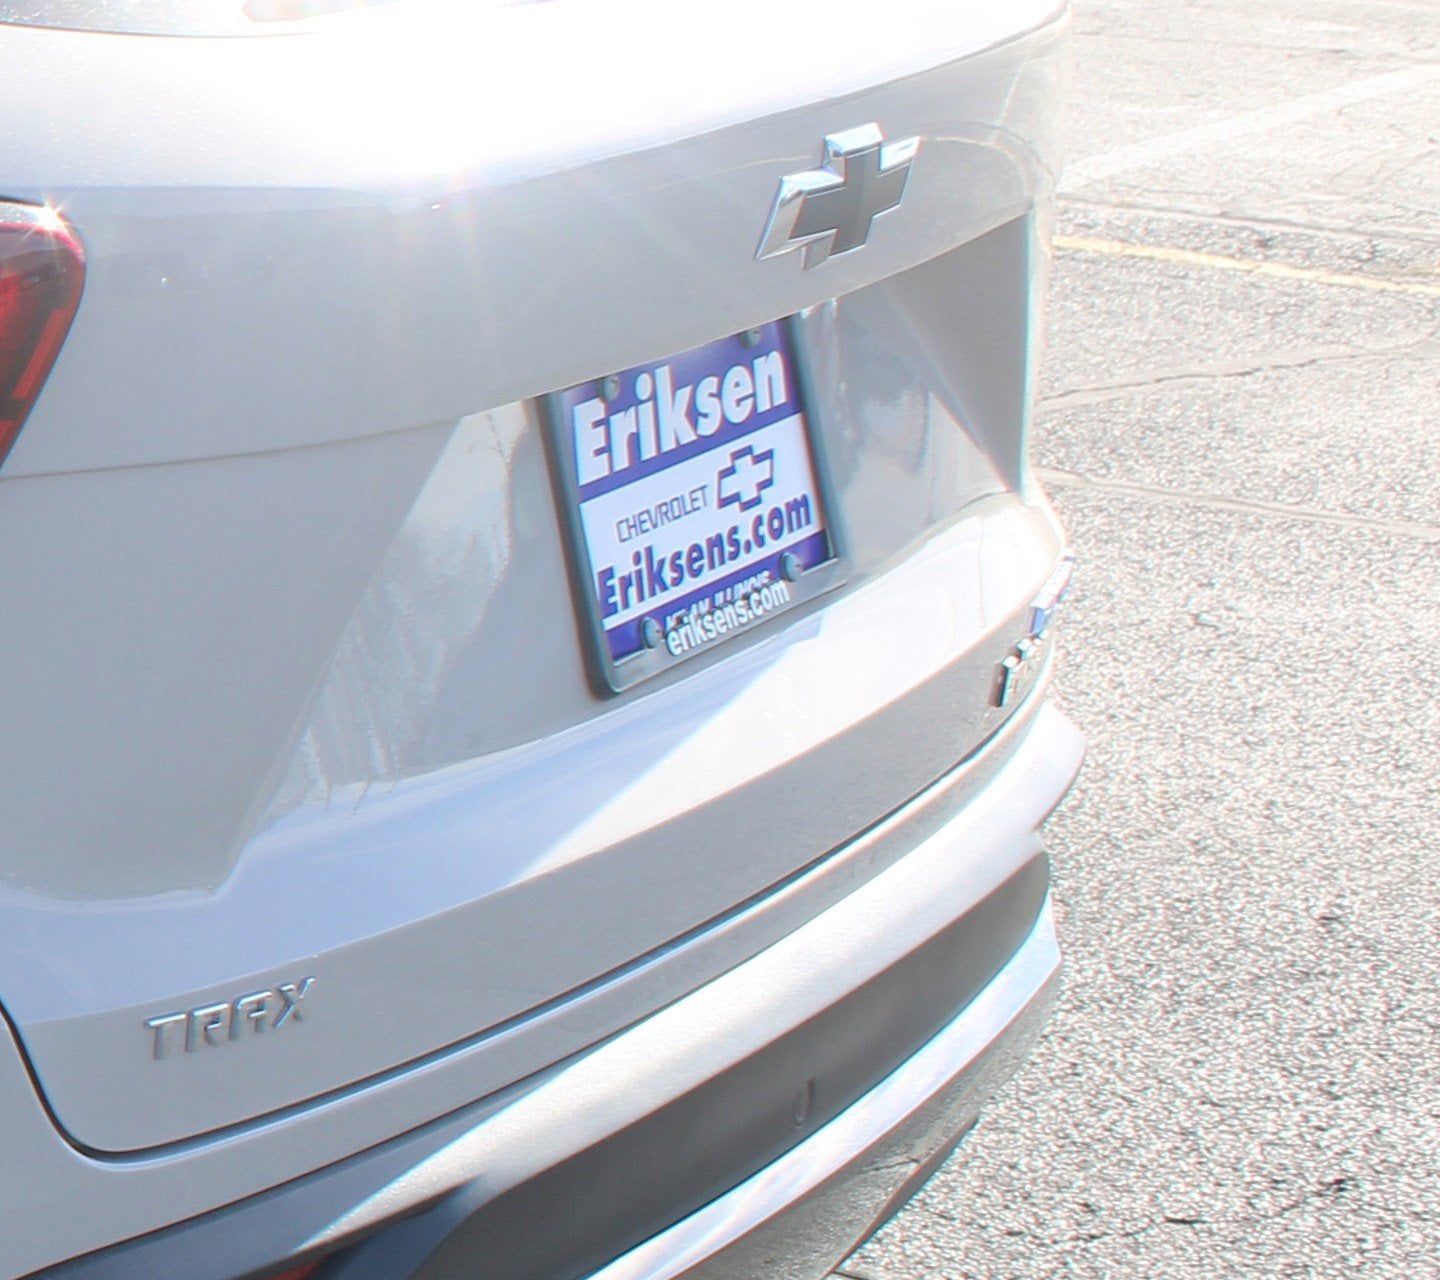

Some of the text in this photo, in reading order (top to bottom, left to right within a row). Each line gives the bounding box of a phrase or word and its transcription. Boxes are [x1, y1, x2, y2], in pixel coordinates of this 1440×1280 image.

[572, 349, 788, 487] Eriksen
[597, 491, 812, 620] Eriksens.com
[616, 484, 710, 543] CHEVROLET
[665, 578, 791, 657] eriksens.com
[143, 975, 316, 1061] TRAX
